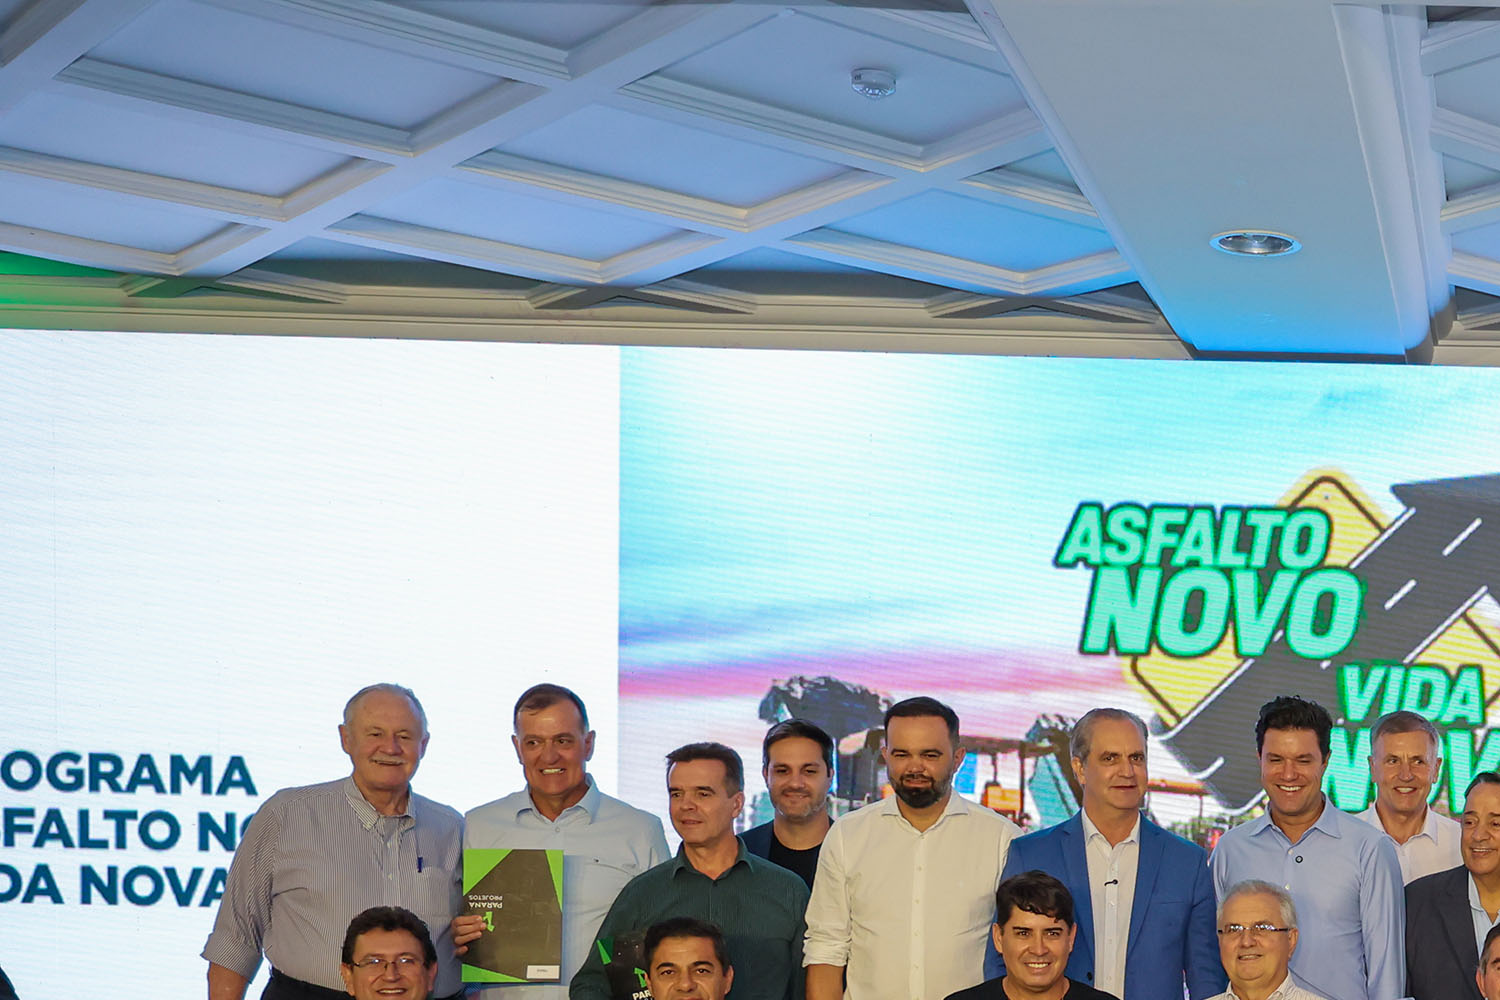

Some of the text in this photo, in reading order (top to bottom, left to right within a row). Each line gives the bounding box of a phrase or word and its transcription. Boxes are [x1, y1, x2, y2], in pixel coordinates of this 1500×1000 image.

[1055, 502, 1332, 569] ASFALTO
[1080, 565, 1363, 659] NOVO
[1340, 662, 1487, 726] VIDA
[0, 808, 181, 850] FALTO
[80, 865, 229, 907] NOVA
